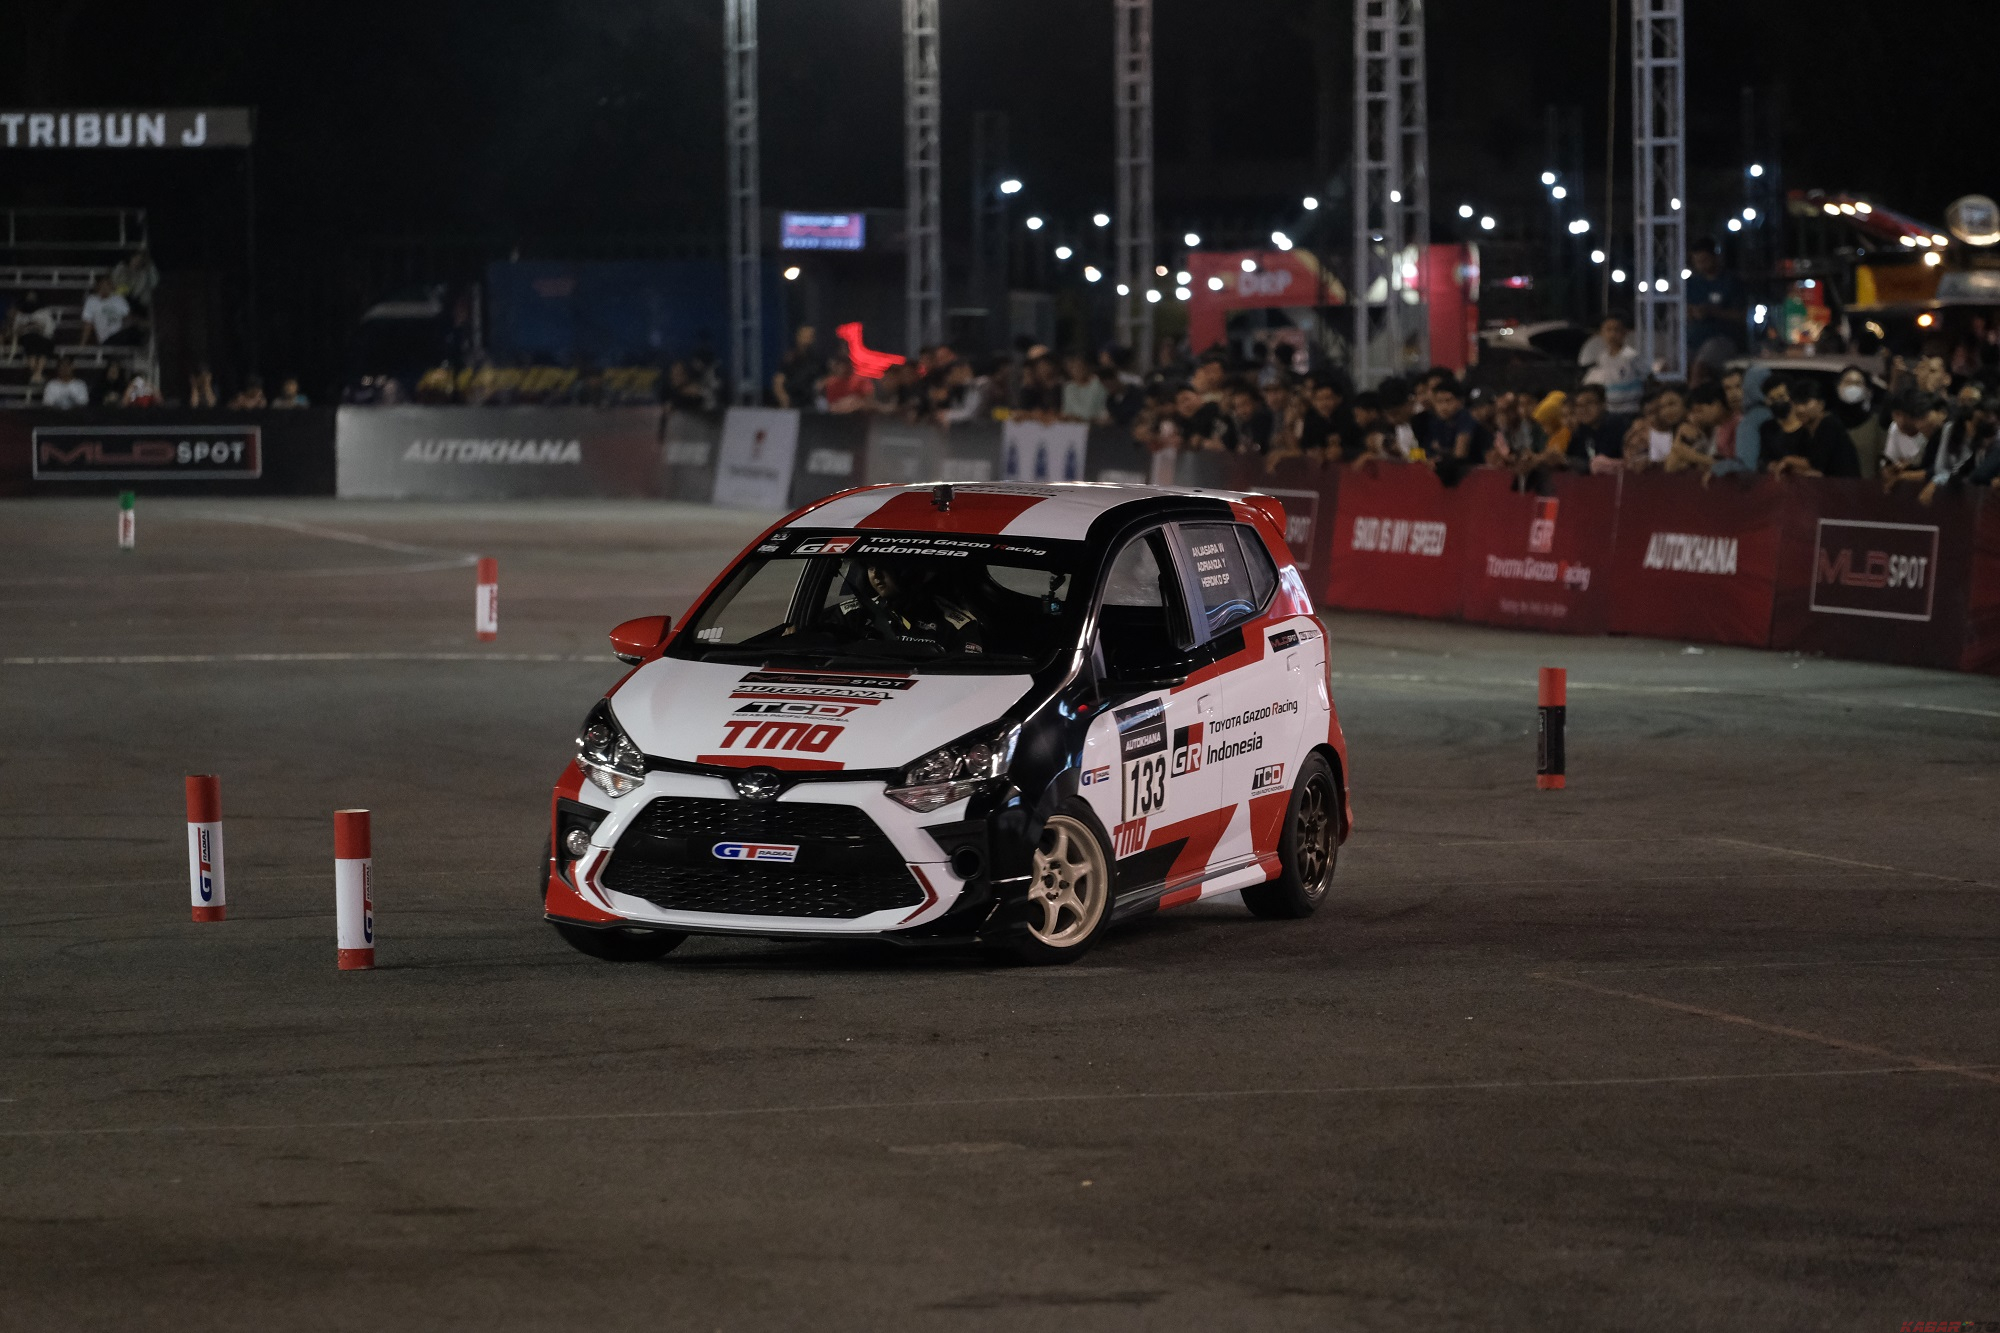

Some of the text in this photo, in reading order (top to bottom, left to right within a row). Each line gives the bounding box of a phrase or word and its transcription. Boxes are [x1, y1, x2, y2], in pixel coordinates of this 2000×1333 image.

[0, 112, 207, 148] TRIBUN J
[403, 438, 582, 464] AUTOKHANA
[795, 542, 851, 553] GR
[857, 544, 969, 557] Indonesia
[869, 536, 1047, 556] TOYOTA GAZOO Racing
[1643, 531, 1738, 576] AUTOKHANA
[733, 686, 890, 699] AUTOKHANA
[751, 702, 846, 716] TCD
[1209, 699, 1298, 734] TOYOTA GAZOO Racing
[719, 720, 846, 753] TMO
[1125, 732, 1161, 752] AUTOKHANA
[1206, 731, 1263, 765] Indonesia
[1172, 742, 1202, 775] GR
[1131, 754, 1166, 817] 133
[1255, 764, 1282, 788] TCD
[714, 843, 758, 859] GT
[1113, 817, 1147, 857] TMO
[199, 861, 213, 902] GT
